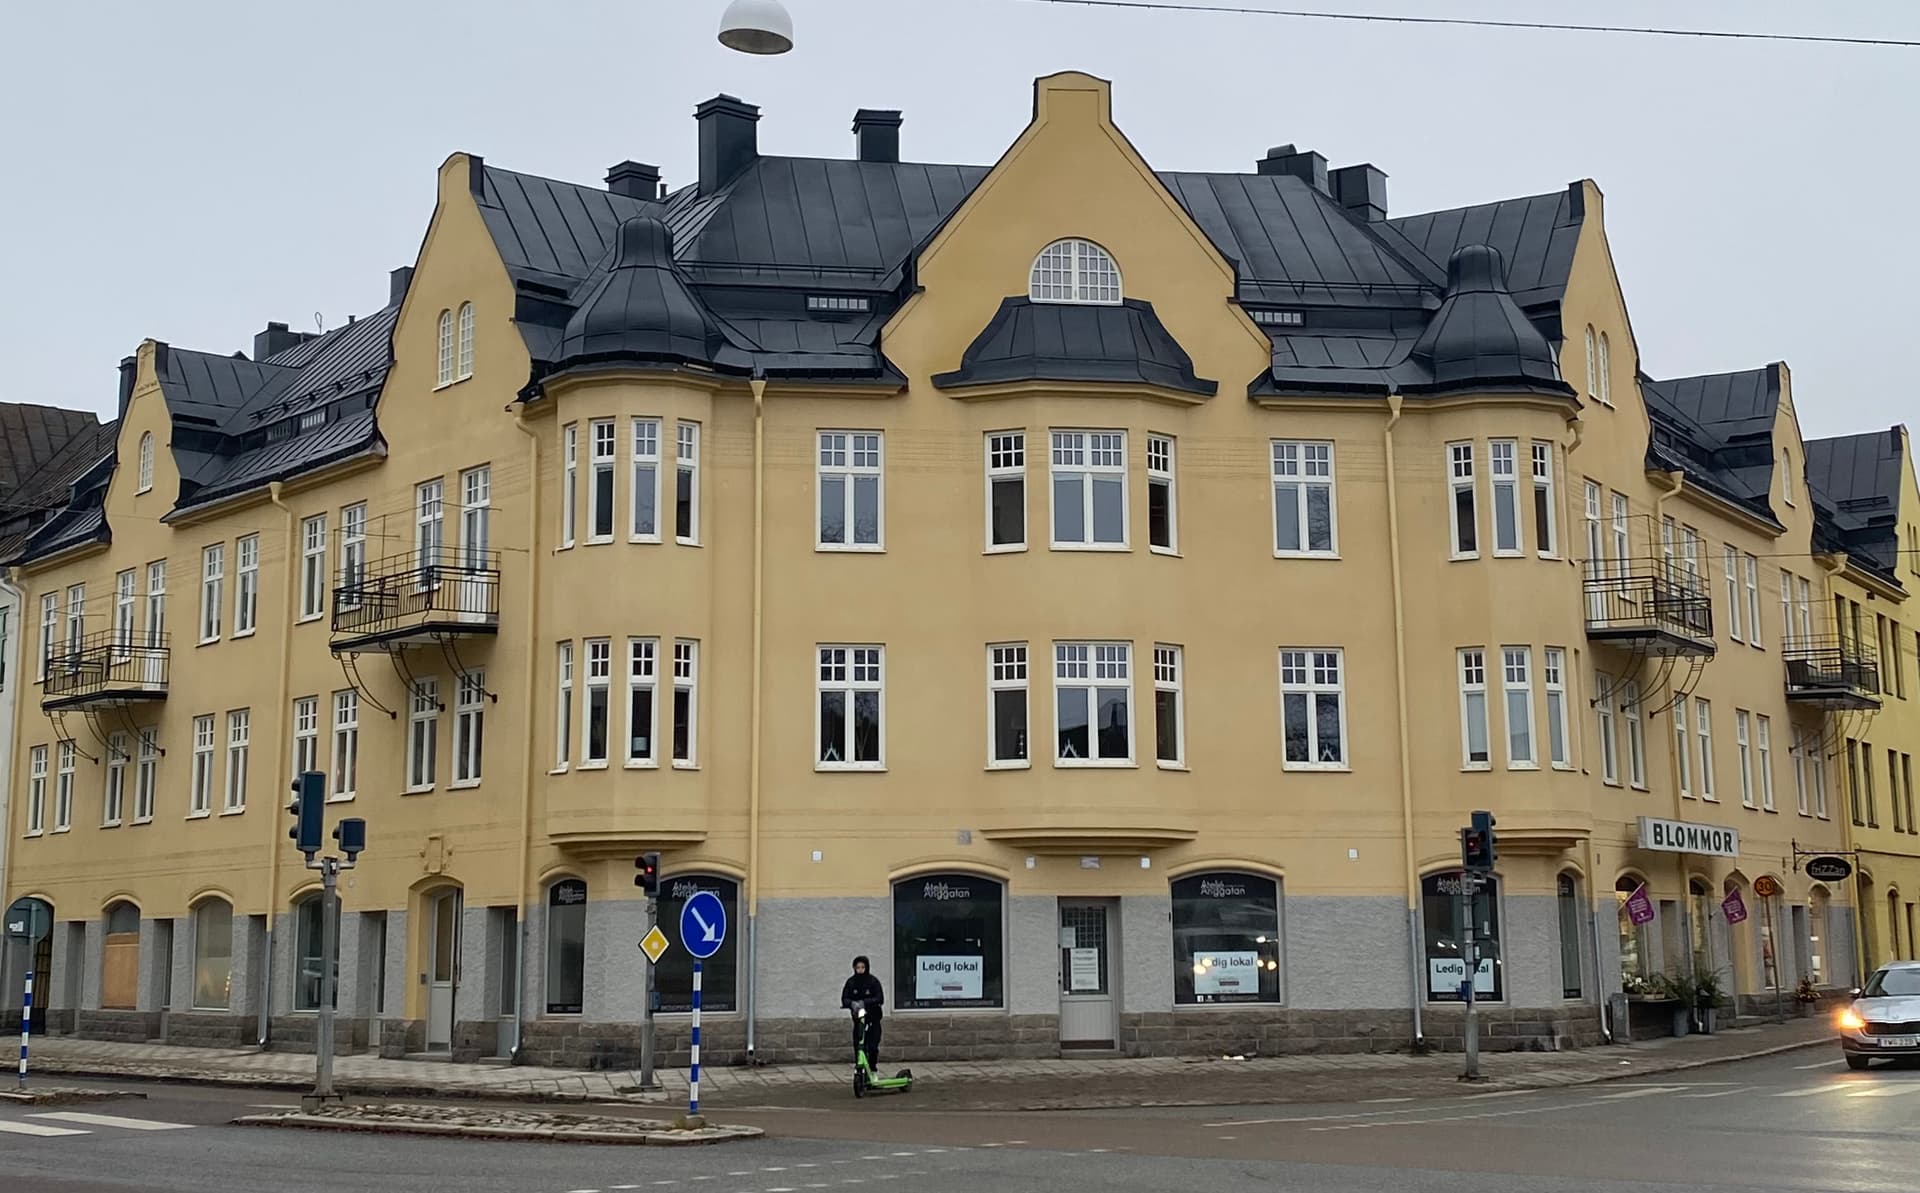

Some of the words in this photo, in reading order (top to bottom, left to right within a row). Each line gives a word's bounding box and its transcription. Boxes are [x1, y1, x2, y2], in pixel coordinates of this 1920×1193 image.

[1653, 823, 1733, 853] BLOMMOR
[1758, 881, 1772, 891] 30
[922, 961, 951, 973] Ledig
[953, 961, 978, 971] lokal
[1230, 957, 1254, 966] lokal
[1435, 963, 1463, 975] Ledig
